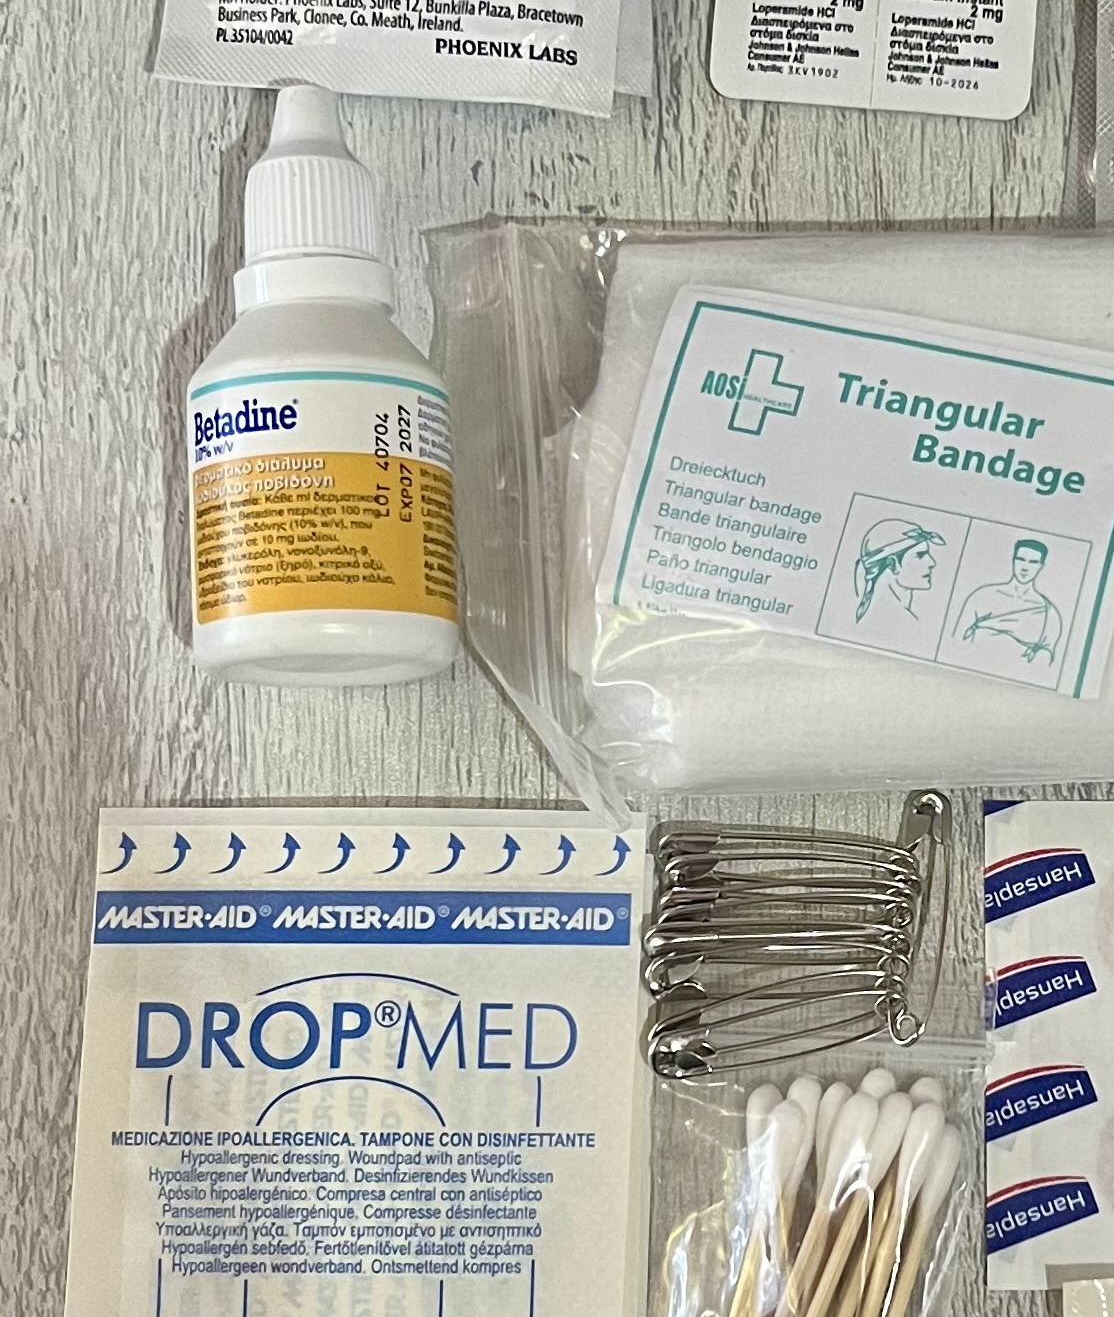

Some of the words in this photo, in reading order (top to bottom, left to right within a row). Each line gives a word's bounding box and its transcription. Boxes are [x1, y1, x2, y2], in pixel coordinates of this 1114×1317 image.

[970, 5, 978, 17] 2
[982, 9, 1003, 23] mg
[436, 38, 523, 58] PHOENIX
[529, 45, 578, 65] LABS
[701, 370, 738, 399] AOS
[194, 398, 297, 446] Betadine
[837, 373, 1045, 440] Triangular
[375, 413, 389, 472] 40704
[399, 405, 412, 452] 2027
[670, 456, 766, 487] Dreiecktuch
[913, 434, 1086, 495] Bandage
[374, 483, 390, 517] LOT
[665, 480, 745, 507] Triangular
[750, 497, 822, 524] bandage
[658, 503, 710, 525] Bande
[716, 515, 807, 543] triangulaire
[653, 525, 726, 551] Triangolo
[732, 540, 818, 570] bendaggio
[647, 549, 689, 569] Paño
[695, 560, 772, 585] triangular
[642, 574, 710, 599] Ligadura
[716, 589, 793, 615] triangular
[112, 1131, 213, 1146] MEDICAZIONE
[217, 1131, 355, 1146] IPOALLERGENICA.
[360, 1132, 435, 1147] TAMPONE
[439, 1132, 473, 1147] CON
[478, 1133, 595, 1148] DISINFETTANTE
[181, 1150, 279, 1167] Hypoallergenic
[348, 1151, 421, 1169] Woundpad
[425, 1151, 453, 1165] with
[457, 1151, 522, 1168] antiseptic
[163, 1204, 235, 1219] Pansement
[363, 1204, 441, 1222] Compresse
[446, 1205, 537, 1220] désinfectante
